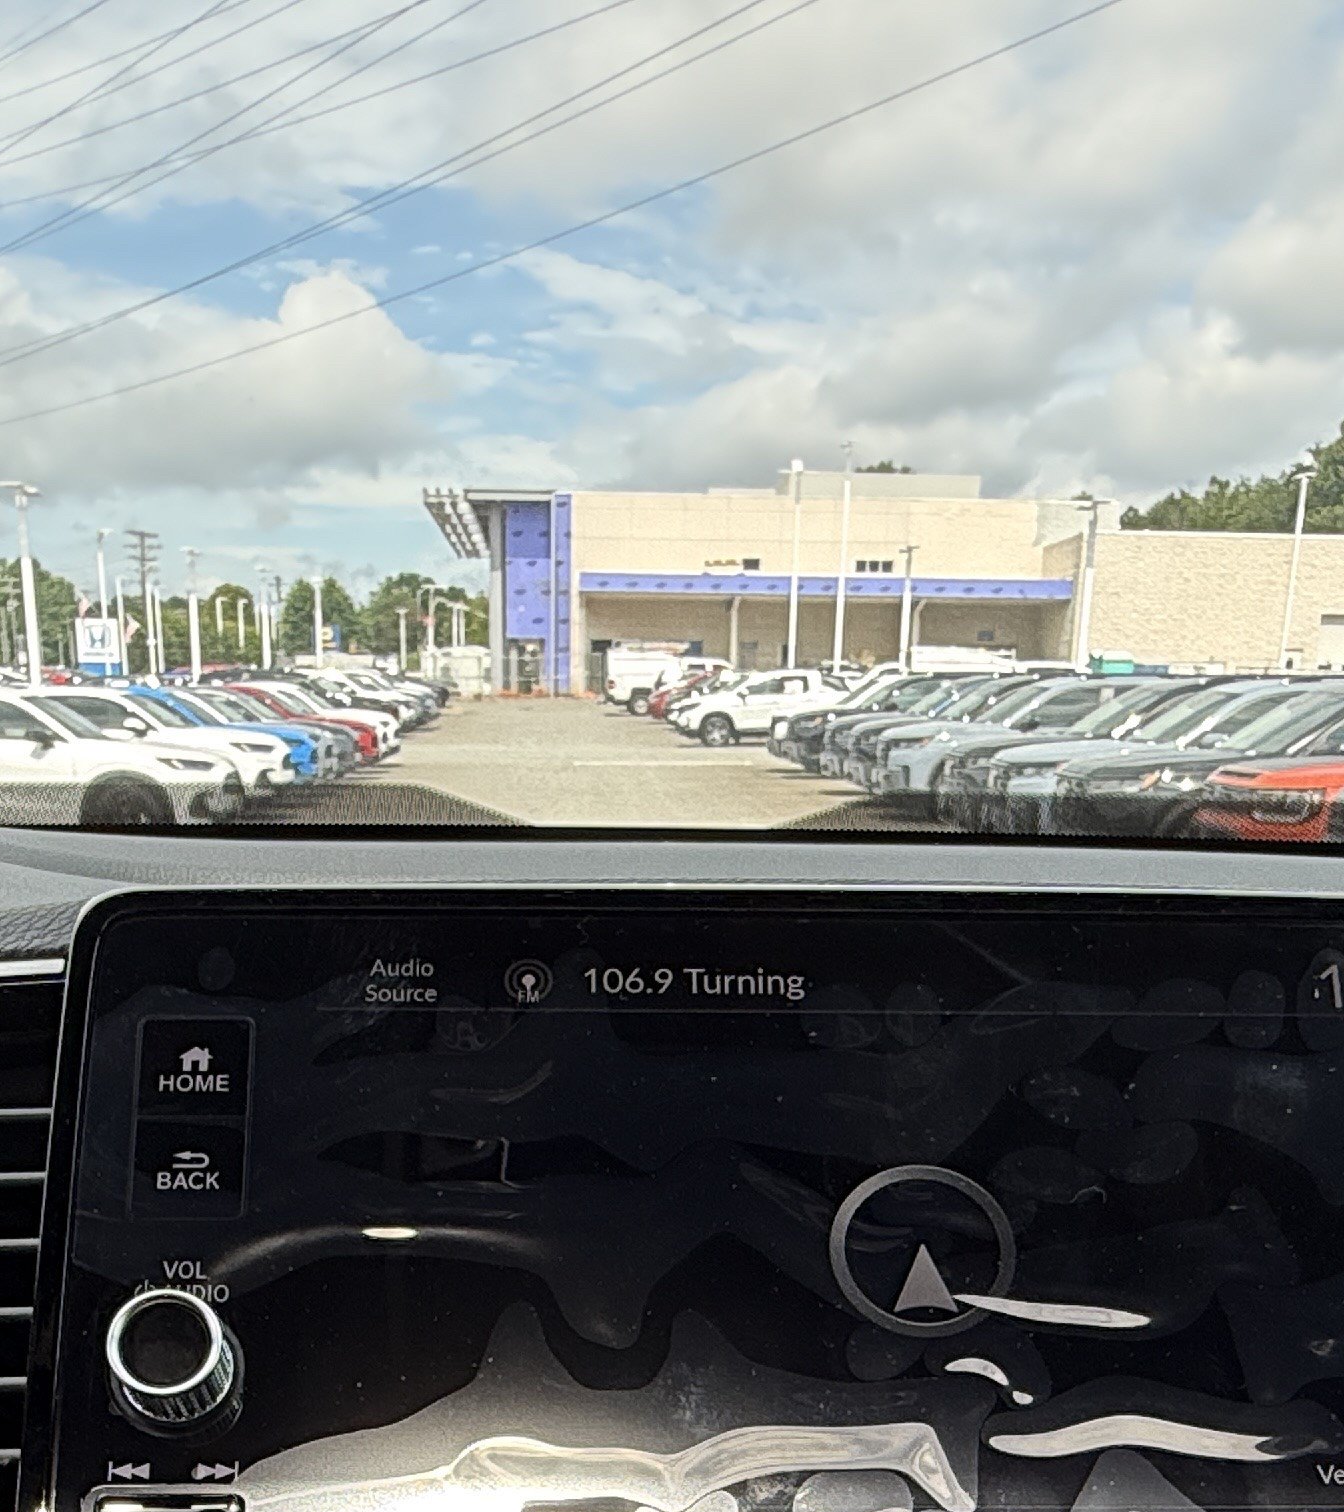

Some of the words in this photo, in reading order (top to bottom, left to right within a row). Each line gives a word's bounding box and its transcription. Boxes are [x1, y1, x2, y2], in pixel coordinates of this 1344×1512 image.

[369, 958, 434, 978] Audio
[364, 983, 438, 1003] Source
[584, 967, 674, 994] 106.9
[682, 967, 806, 1001] Turning
[158, 1072, 230, 1092] HOME
[157, 1169, 221, 1191] BACK
[162, 1260, 208, 1281] VOL
